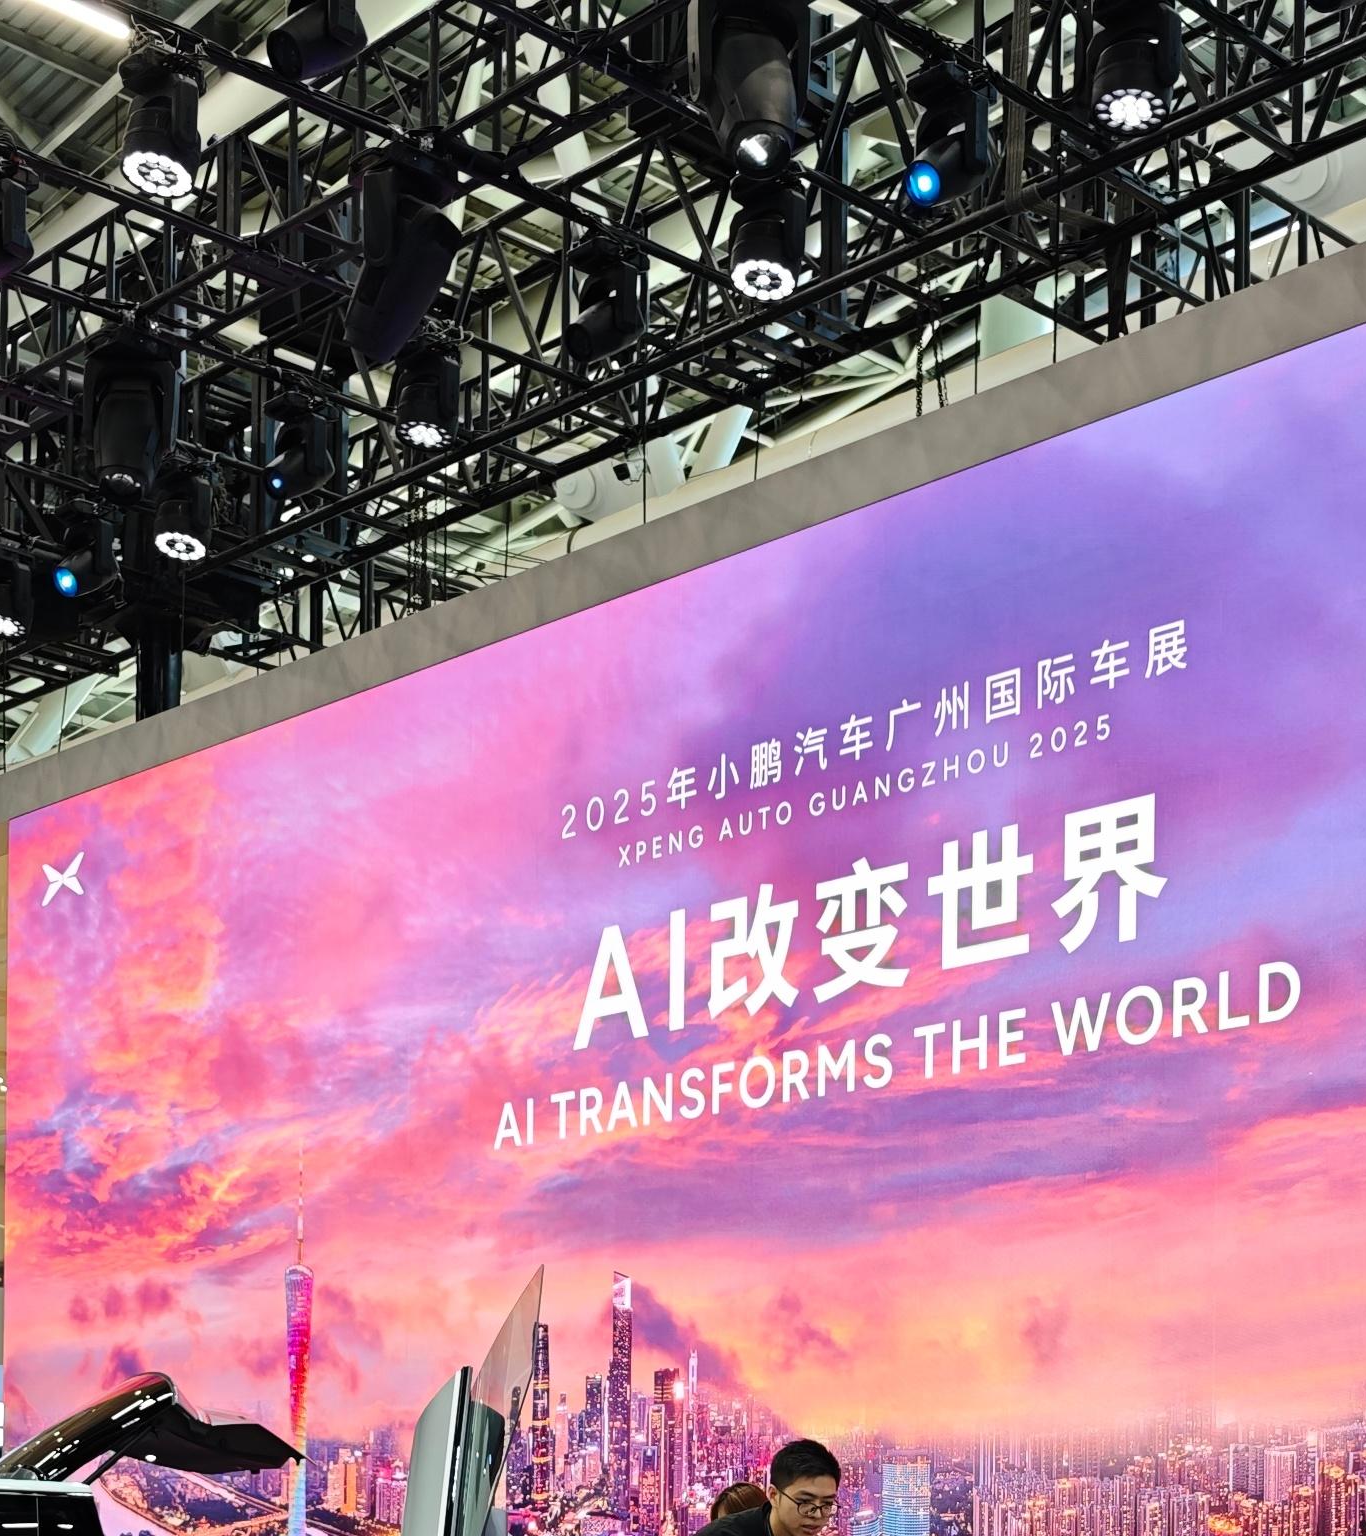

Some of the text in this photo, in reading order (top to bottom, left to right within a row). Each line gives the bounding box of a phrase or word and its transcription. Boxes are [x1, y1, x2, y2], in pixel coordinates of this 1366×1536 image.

[561, 620, 1188, 839] 2025年小鹏汽车广州国际车展
[617, 714, 1112, 868] XPENG AUTO GUANGZHOU 2025
[573, 793, 1168, 1051] AI改变世界
[493, 961, 1302, 1150] AI TRANSFORMS THE WORLD
